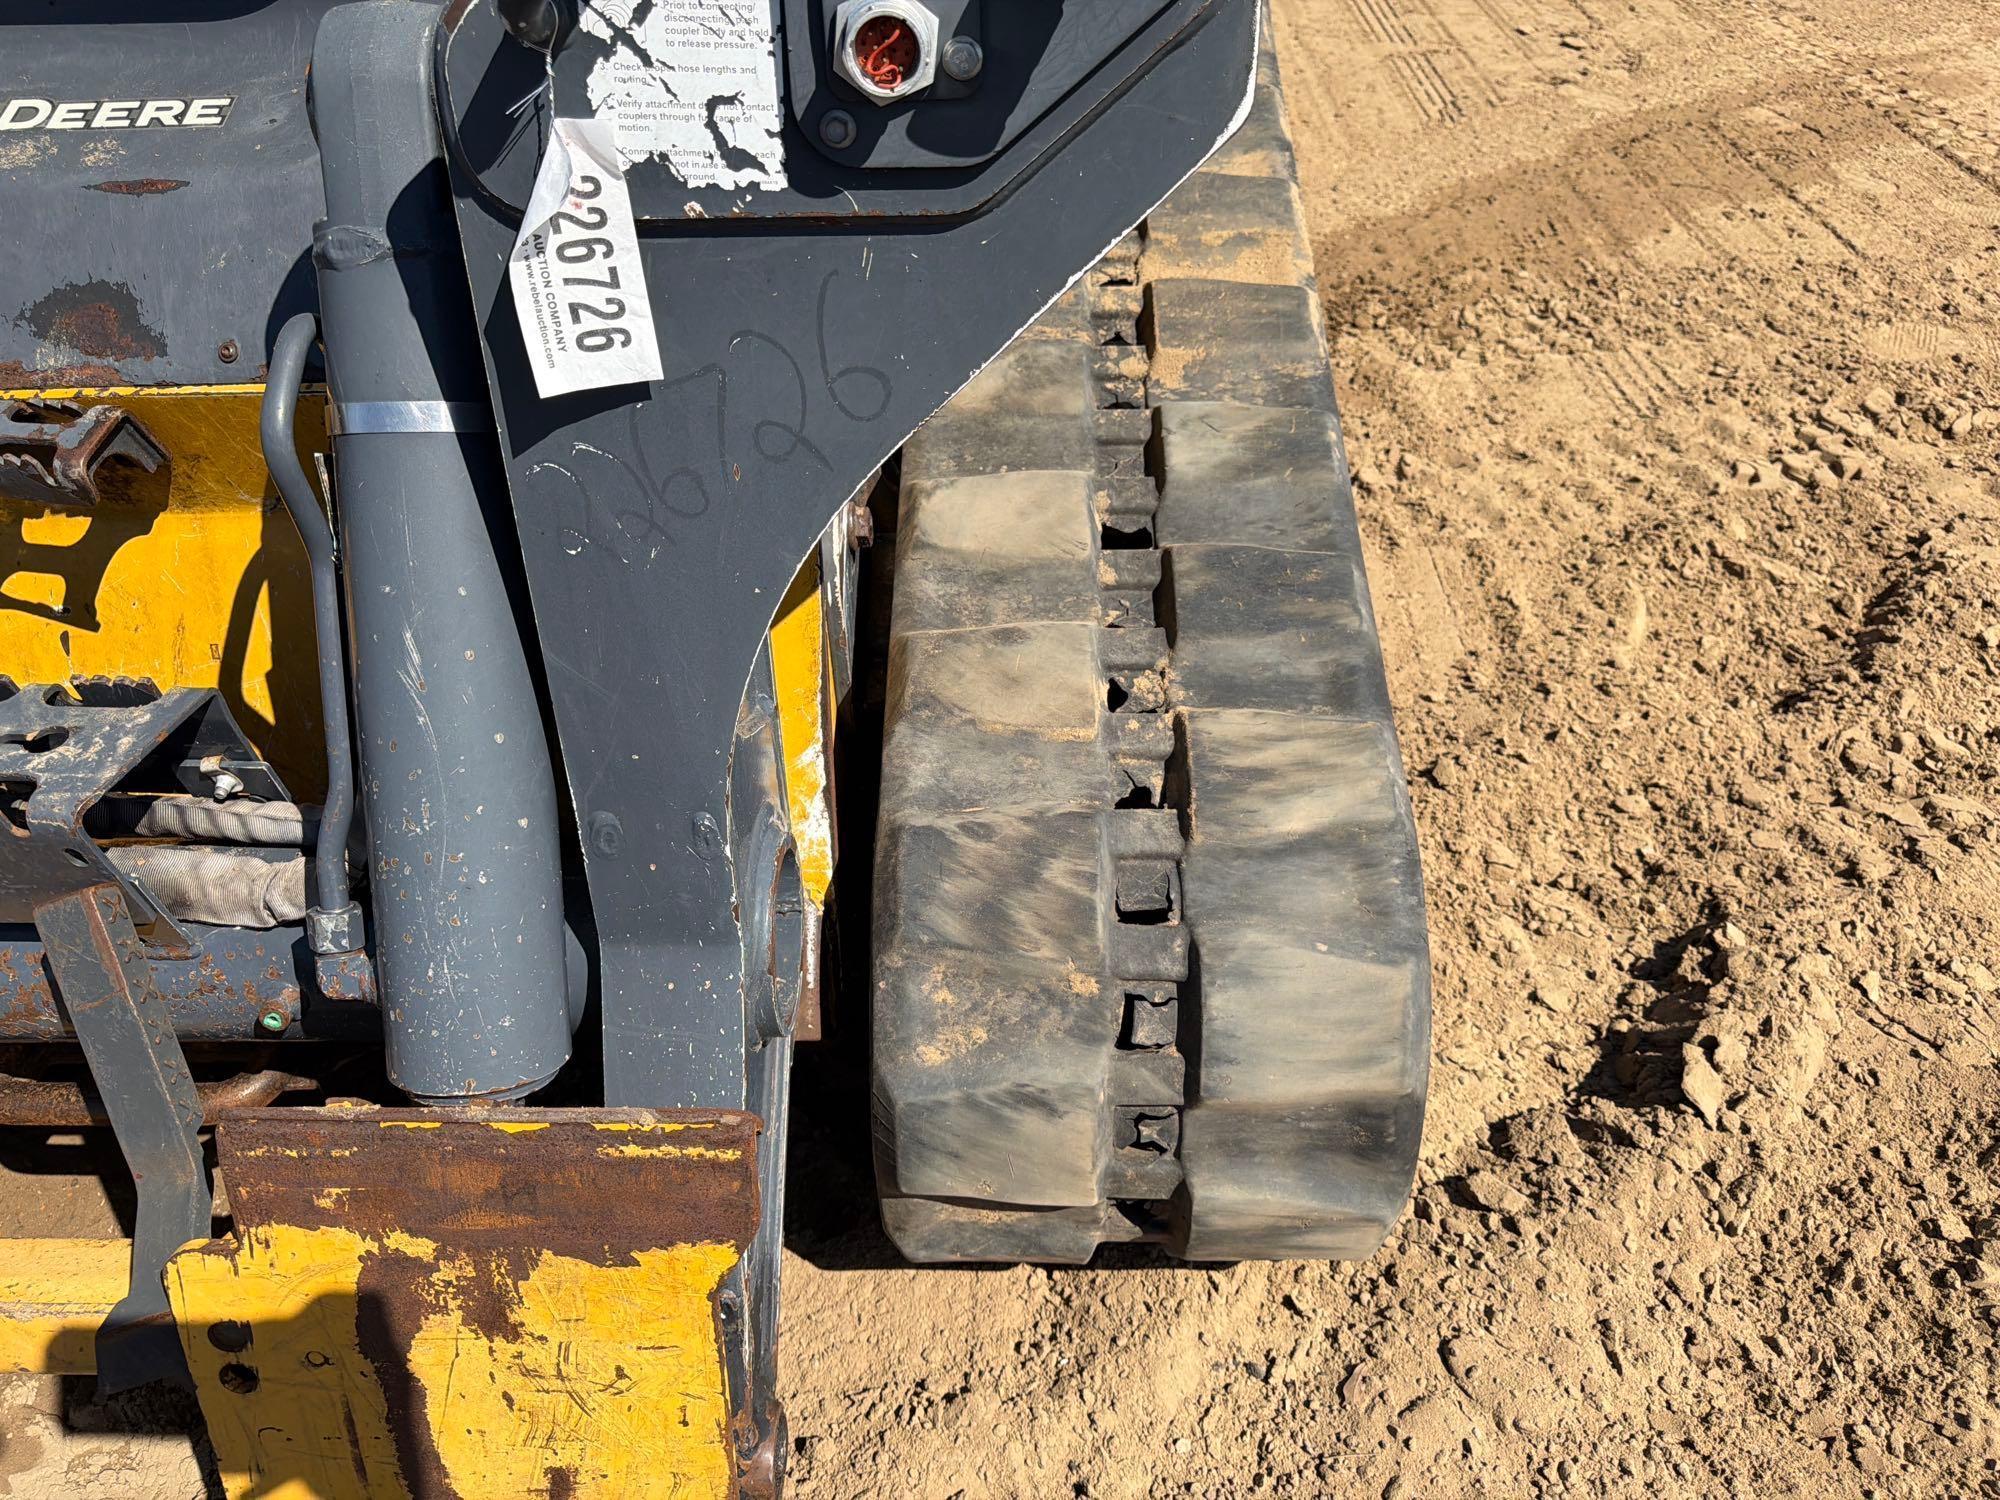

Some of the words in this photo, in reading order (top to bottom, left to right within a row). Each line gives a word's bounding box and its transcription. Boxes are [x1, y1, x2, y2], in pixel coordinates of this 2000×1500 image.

[663, 1, 686, 10] Prior
[689, 1, 698, 10] to
[736, 16, 759, 26] push
[665, 27, 700, 37] coupler
[702, 27, 726, 39] body
[729, 28, 747, 37] and
[749, 28, 769, 37] hold
[666, 39, 675, 48] to
[678, 40, 712, 49] release
[714, 41, 758, 51] pressure.
[613, 62, 642, 71] Check
[677, 63, 700, 73] hose
[703, 64, 737, 75] lengths
[740, 65, 757, 75] and
[616, 99, 643, 110] Verify
[645, 100, 696, 111] attachment
[723, 102, 739, 111] not
[740, 102, 775, 112] contact
[0, 98, 232, 131] DEERE
[617, 112, 658, 122] couplers
[660, 112, 696, 123] through
[743, 114, 753, 123] of
[618, 124, 654, 132] motion.
[675, 161, 689, 170] not
[692, 160, 700, 170] in
[549, 174, 633, 354] 226726
[532, 233, 553, 289] AUCTION
[545, 292, 568, 353] COMPANY
[522, 254, 556, 369] www.rebelauction.com
